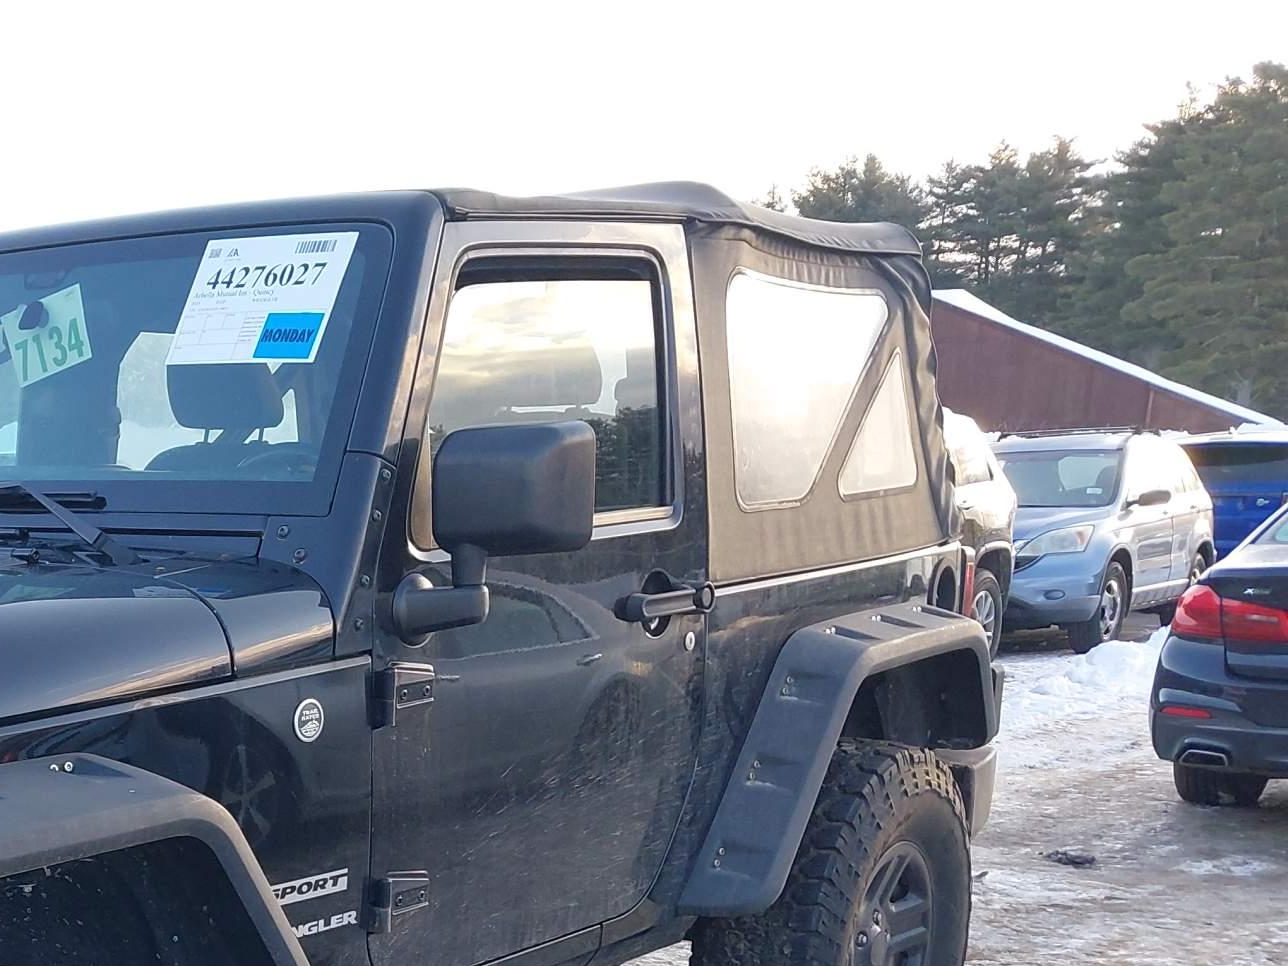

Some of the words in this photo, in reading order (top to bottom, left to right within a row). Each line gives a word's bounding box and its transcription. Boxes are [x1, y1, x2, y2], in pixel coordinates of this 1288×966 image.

[207, 262, 328, 290] 44276027
[261, 329, 315, 343] MONDAY
[14, 318, 84, 382] 7134
[273, 873, 348, 900] SPORT
[291, 911, 358, 938] NGLER
